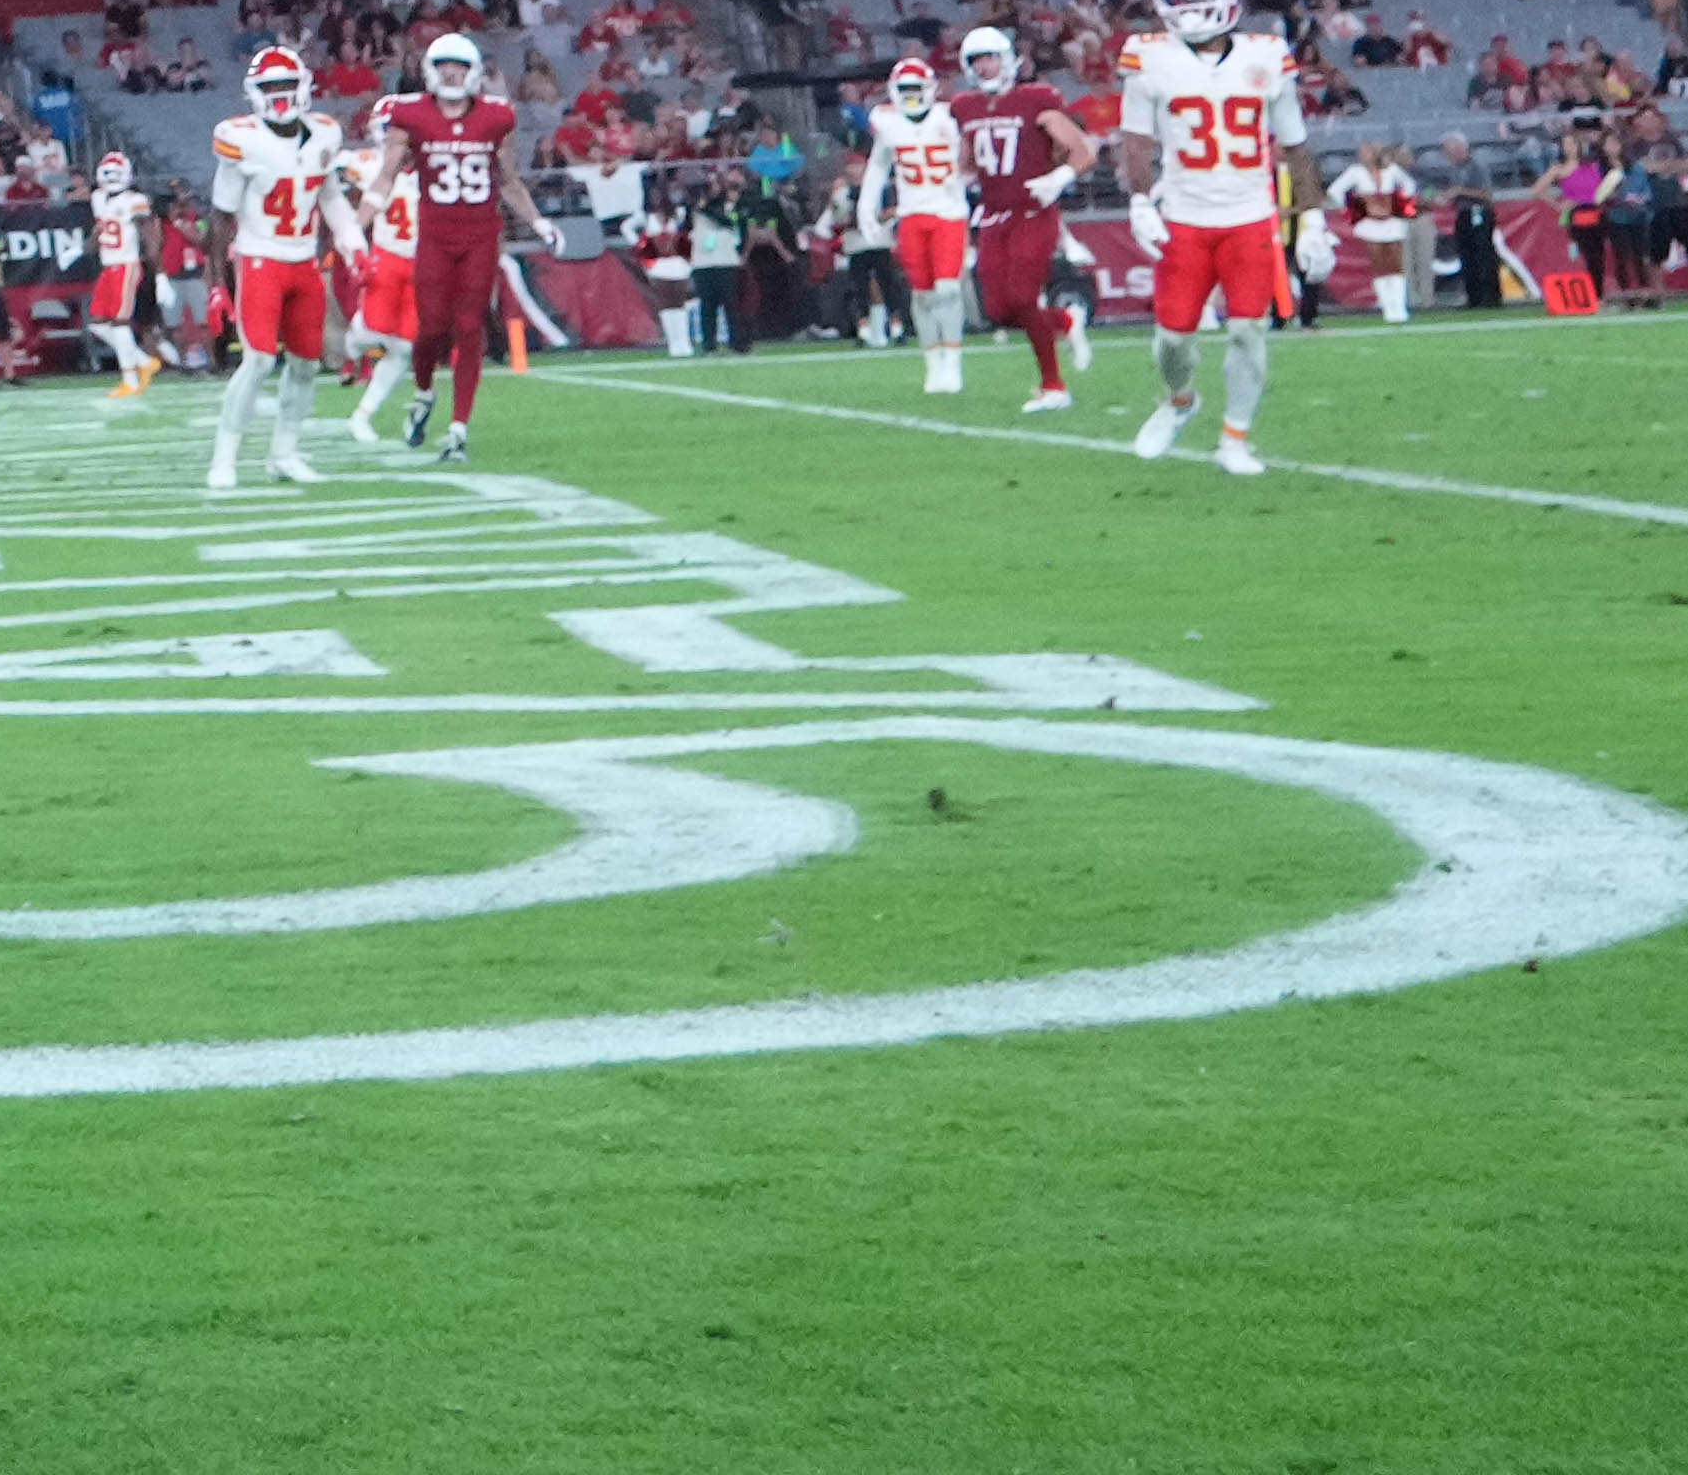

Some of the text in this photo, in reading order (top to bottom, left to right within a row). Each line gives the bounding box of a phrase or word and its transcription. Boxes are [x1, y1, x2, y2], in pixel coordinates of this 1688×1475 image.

[973, 128, 1019, 177] 47
[1168, 95, 1265, 170] 39
[428, 154, 492, 204] 39
[895, 144, 952, 185] 55
[264, 175, 327, 237] 47
[1554, 277, 1591, 311] 10
